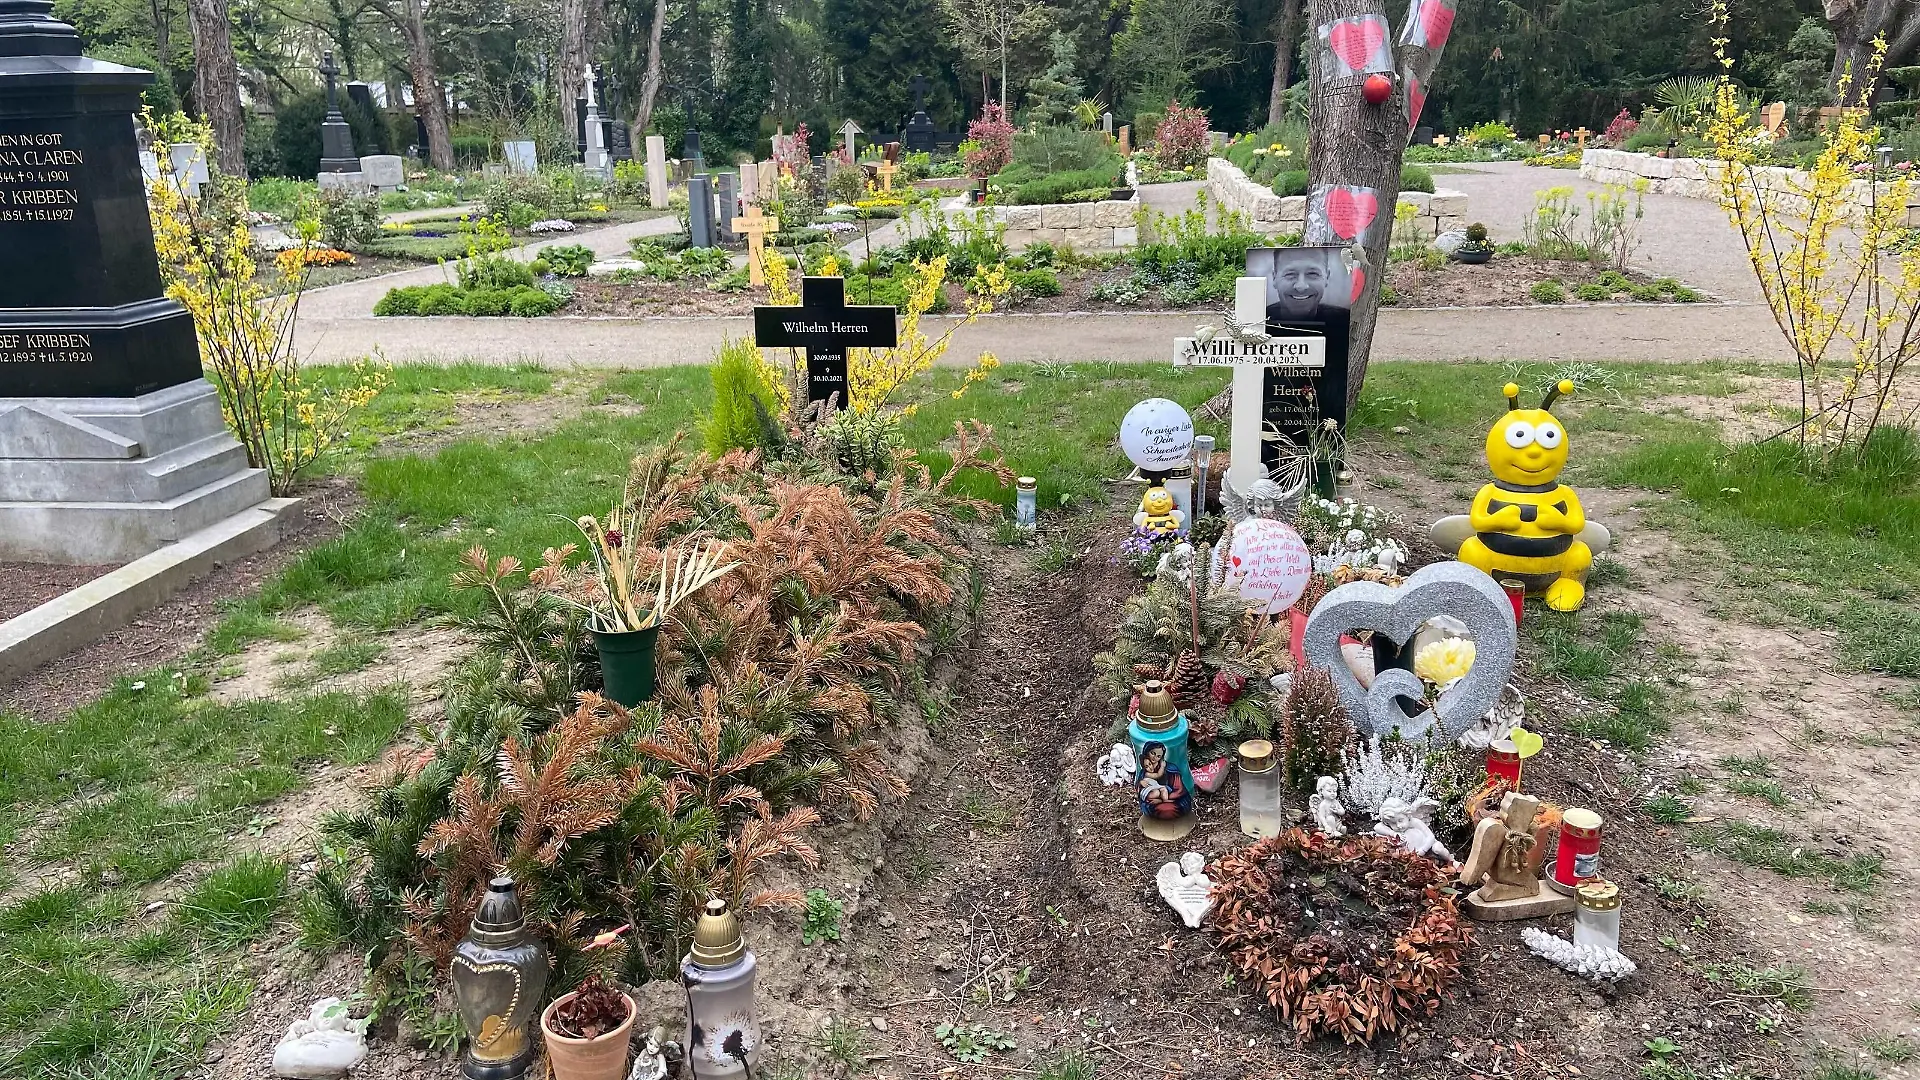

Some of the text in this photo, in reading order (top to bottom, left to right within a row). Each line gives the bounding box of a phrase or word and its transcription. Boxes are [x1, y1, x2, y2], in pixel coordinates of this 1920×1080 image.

[0, 133, 62, 147] EN IN GOTT
[24, 150, 84, 166] CLAREN
[12, 189, 78, 205] KRIBBEN
[782, 322, 869, 333] Wilhelm Herren
[26, 334, 91, 348] KRIBBEN
[1191, 339, 1309, 356] Willi Herren
[1197, 356, 1244, 365] 17.06.1975
[1252, 356, 1301, 365] 20.04.2021
[1271, 366, 1321, 377] Wilhelm
[1272, 384, 1317, 396] Herr
